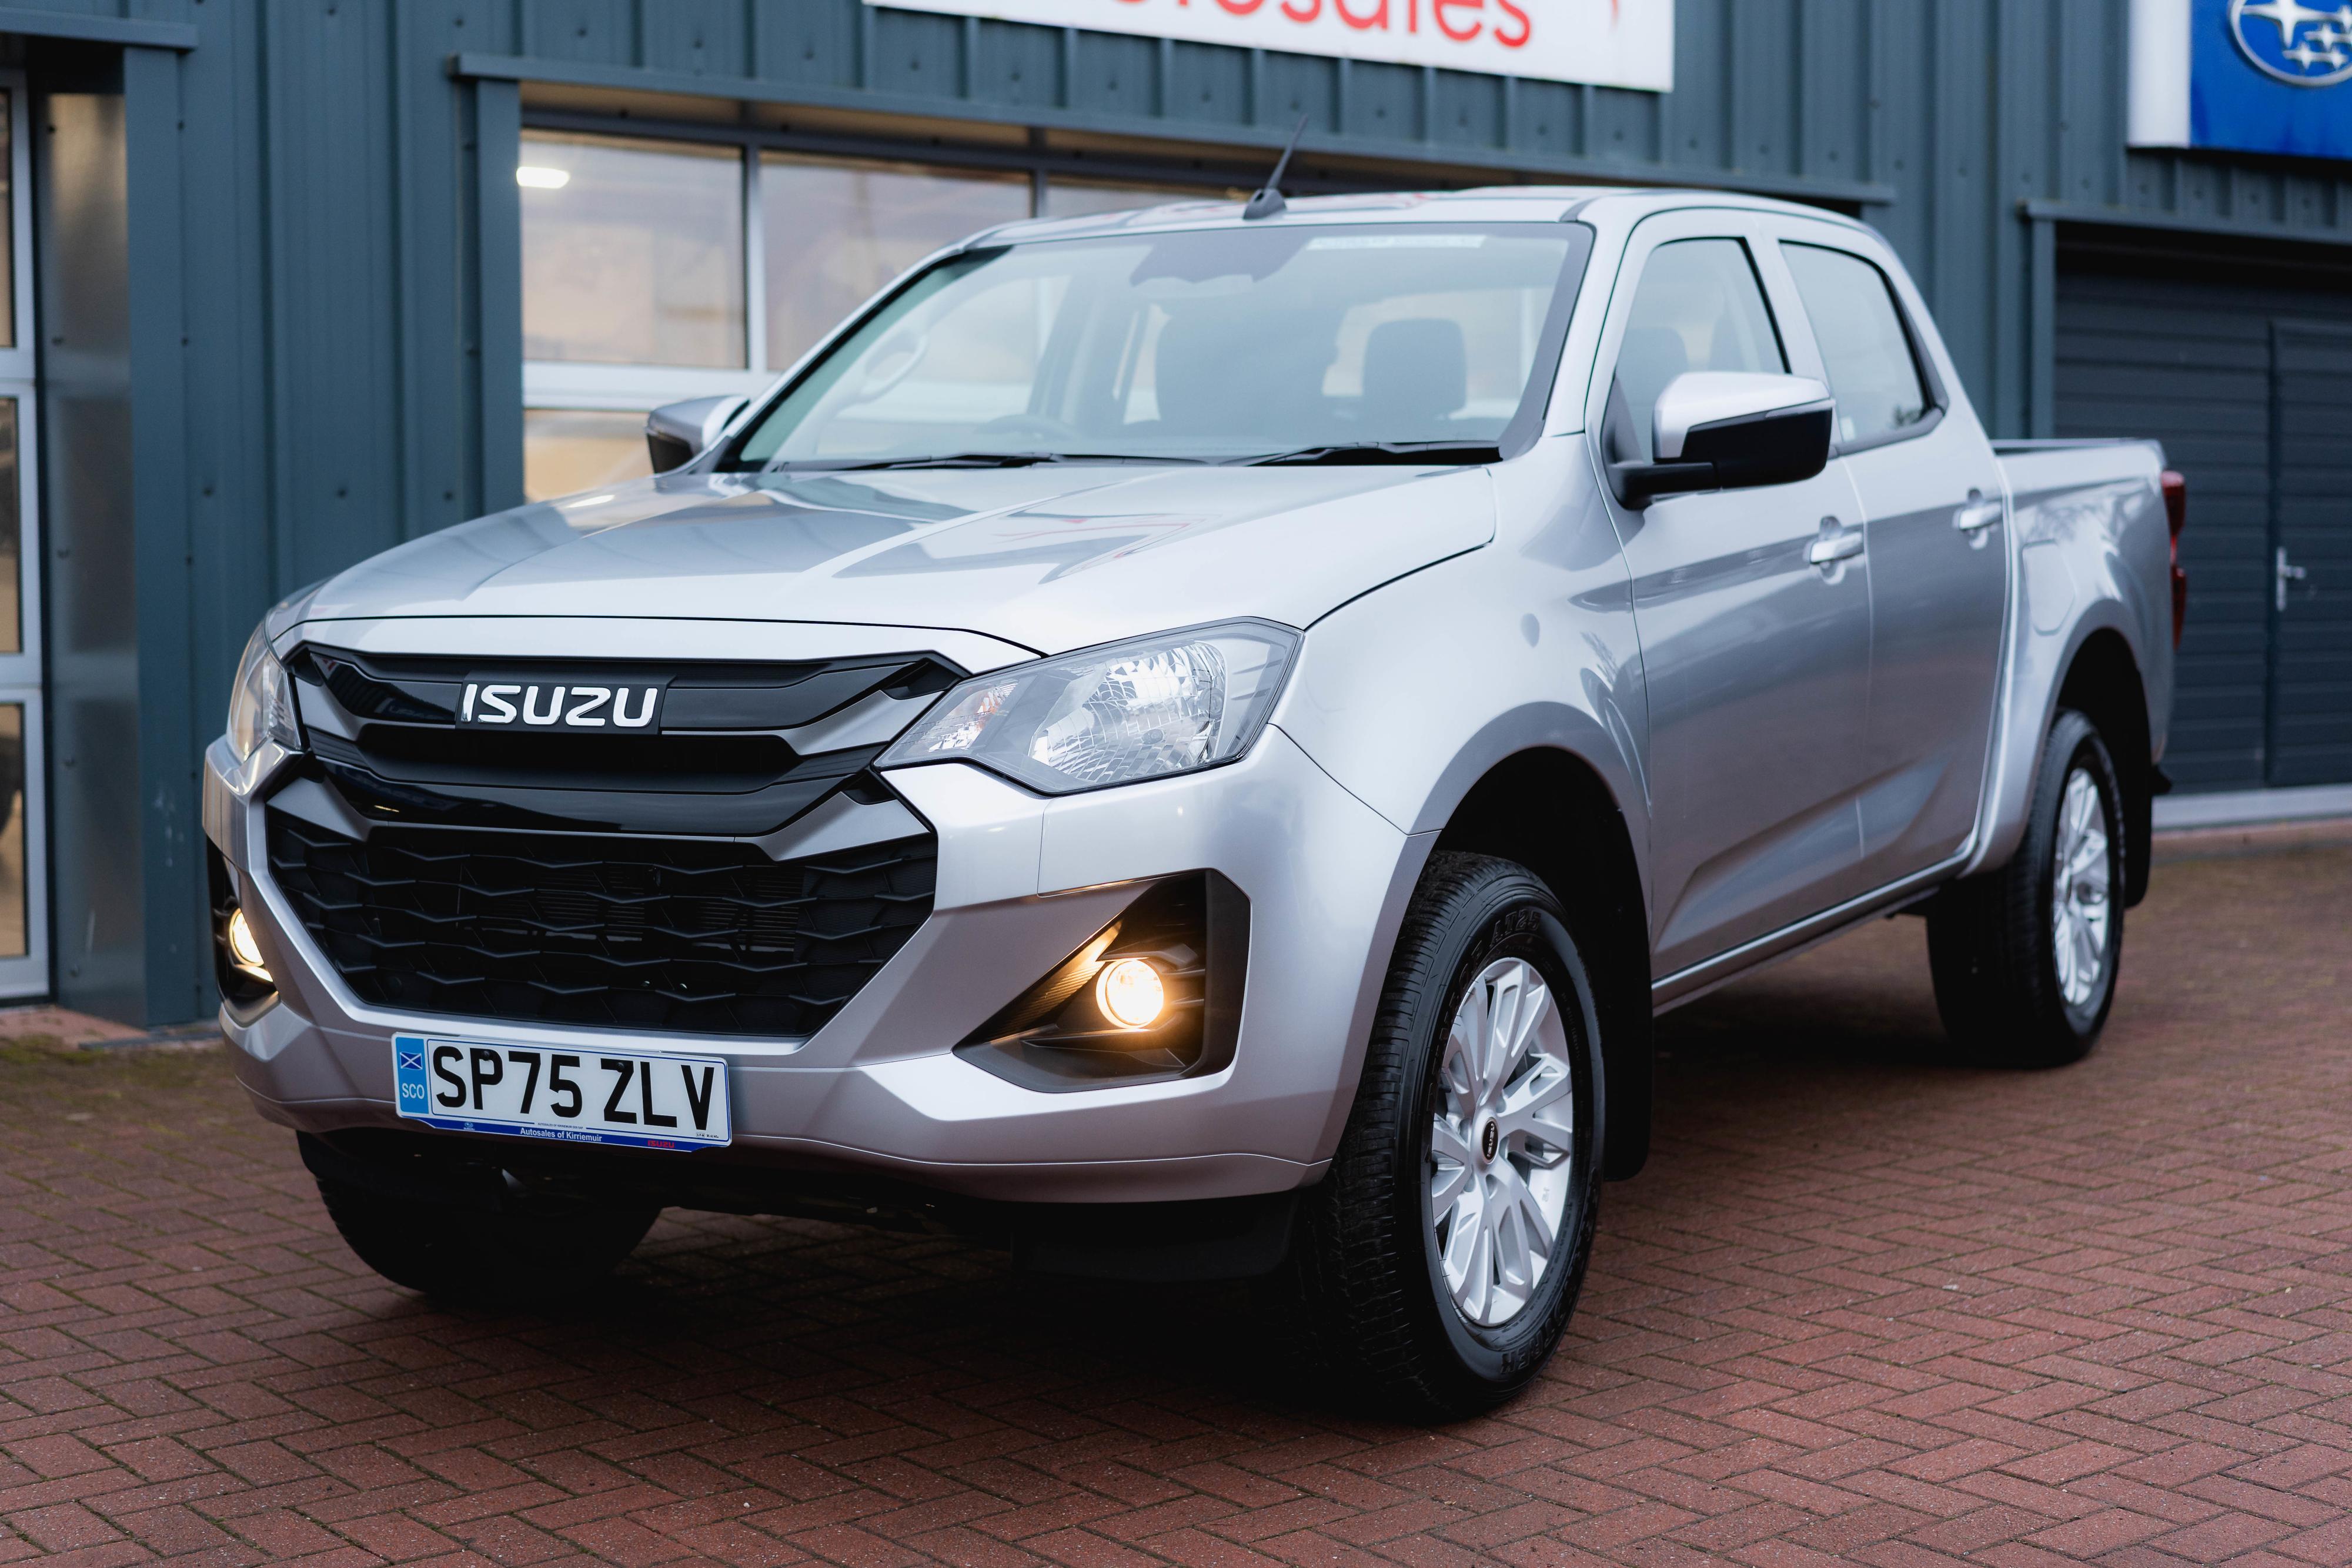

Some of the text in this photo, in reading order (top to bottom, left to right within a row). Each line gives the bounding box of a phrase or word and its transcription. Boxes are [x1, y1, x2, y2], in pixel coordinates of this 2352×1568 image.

[461, 684, 658, 727] ISUZU
[402, 1082, 425, 1099] SCO
[433, 1046, 714, 1131] SP75 ZLV
[520, 1127, 556, 1138] Autosales
[566, 1132, 602, 1142] Kirriemuir
[647, 1140, 674, 1148] ISUZU
